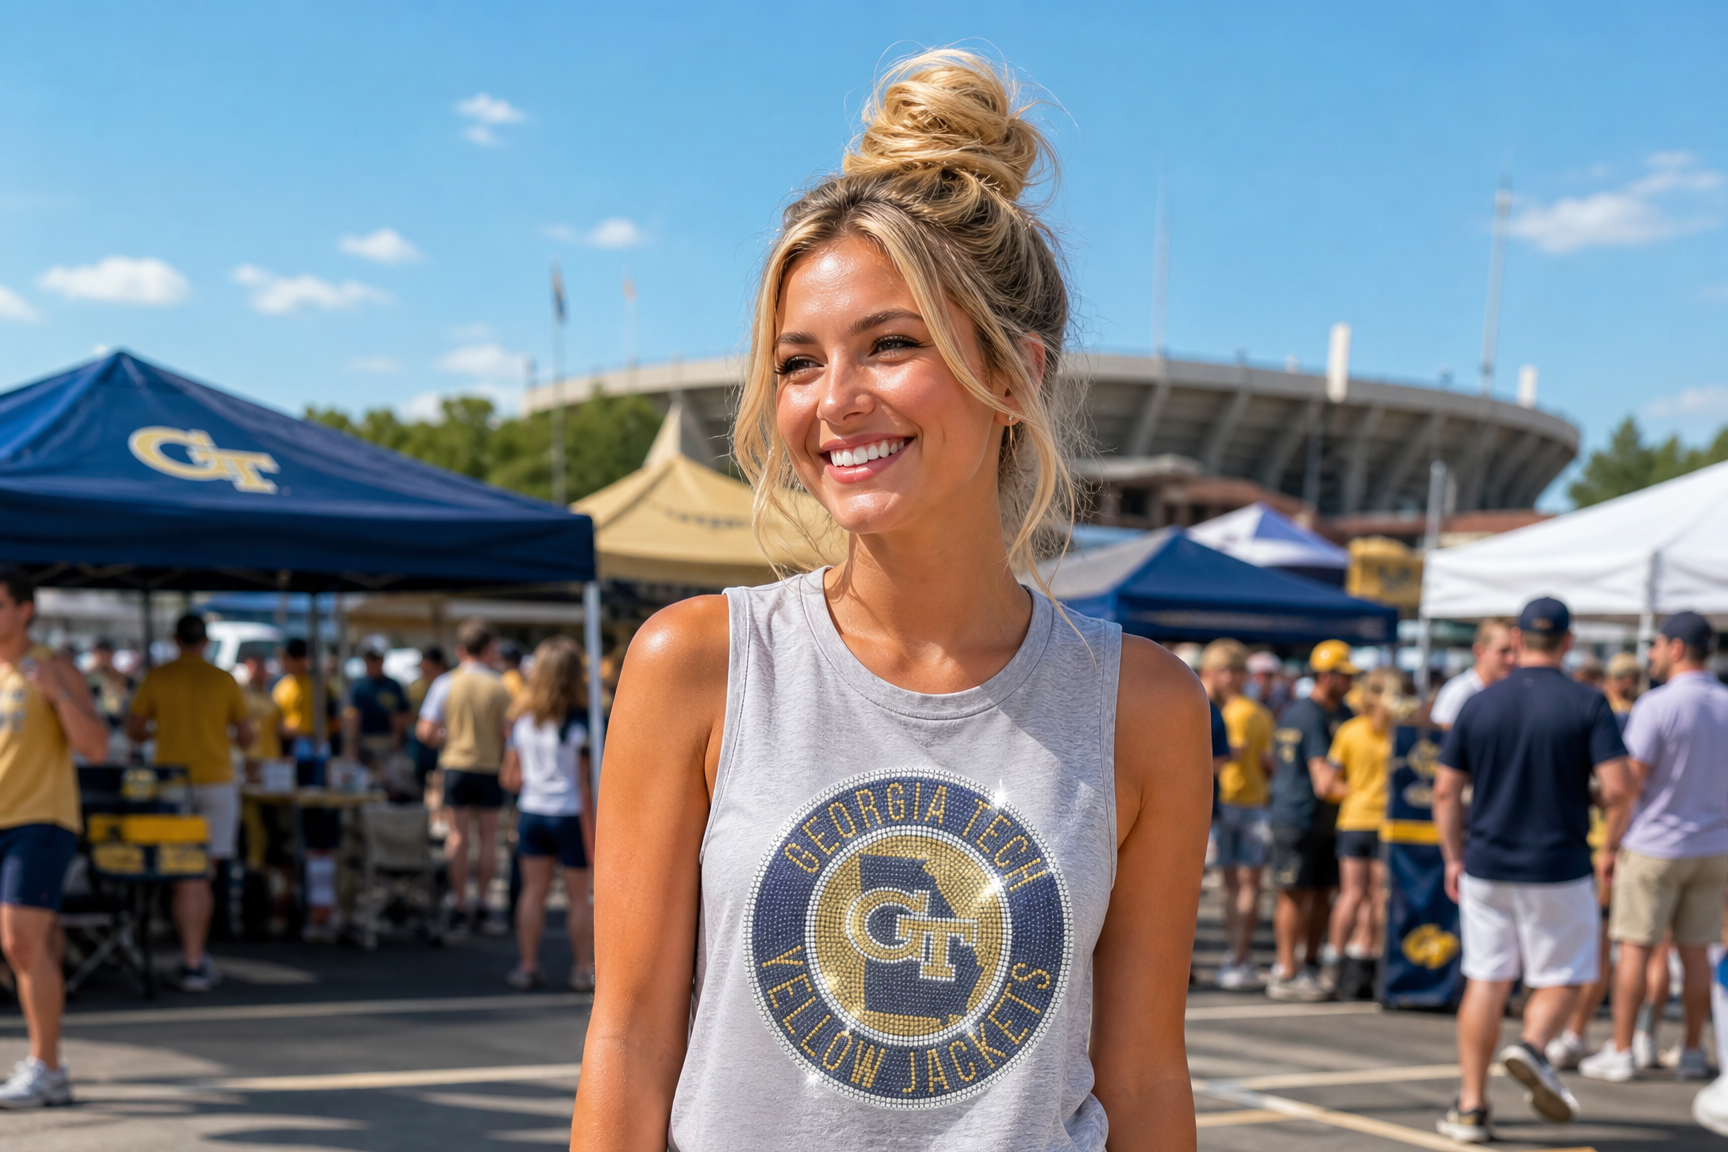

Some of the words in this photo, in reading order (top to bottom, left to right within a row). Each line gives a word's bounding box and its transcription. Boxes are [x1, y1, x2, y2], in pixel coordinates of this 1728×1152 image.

[127, 425, 281, 495] GT
[784, 781, 948, 873] GEORGIA
[962, 798, 1047, 892] TECH
[845, 886, 979, 982] GT
[761, 945, 886, 1089] YELLOW
[902, 962, 1051, 1093] JACKETS
